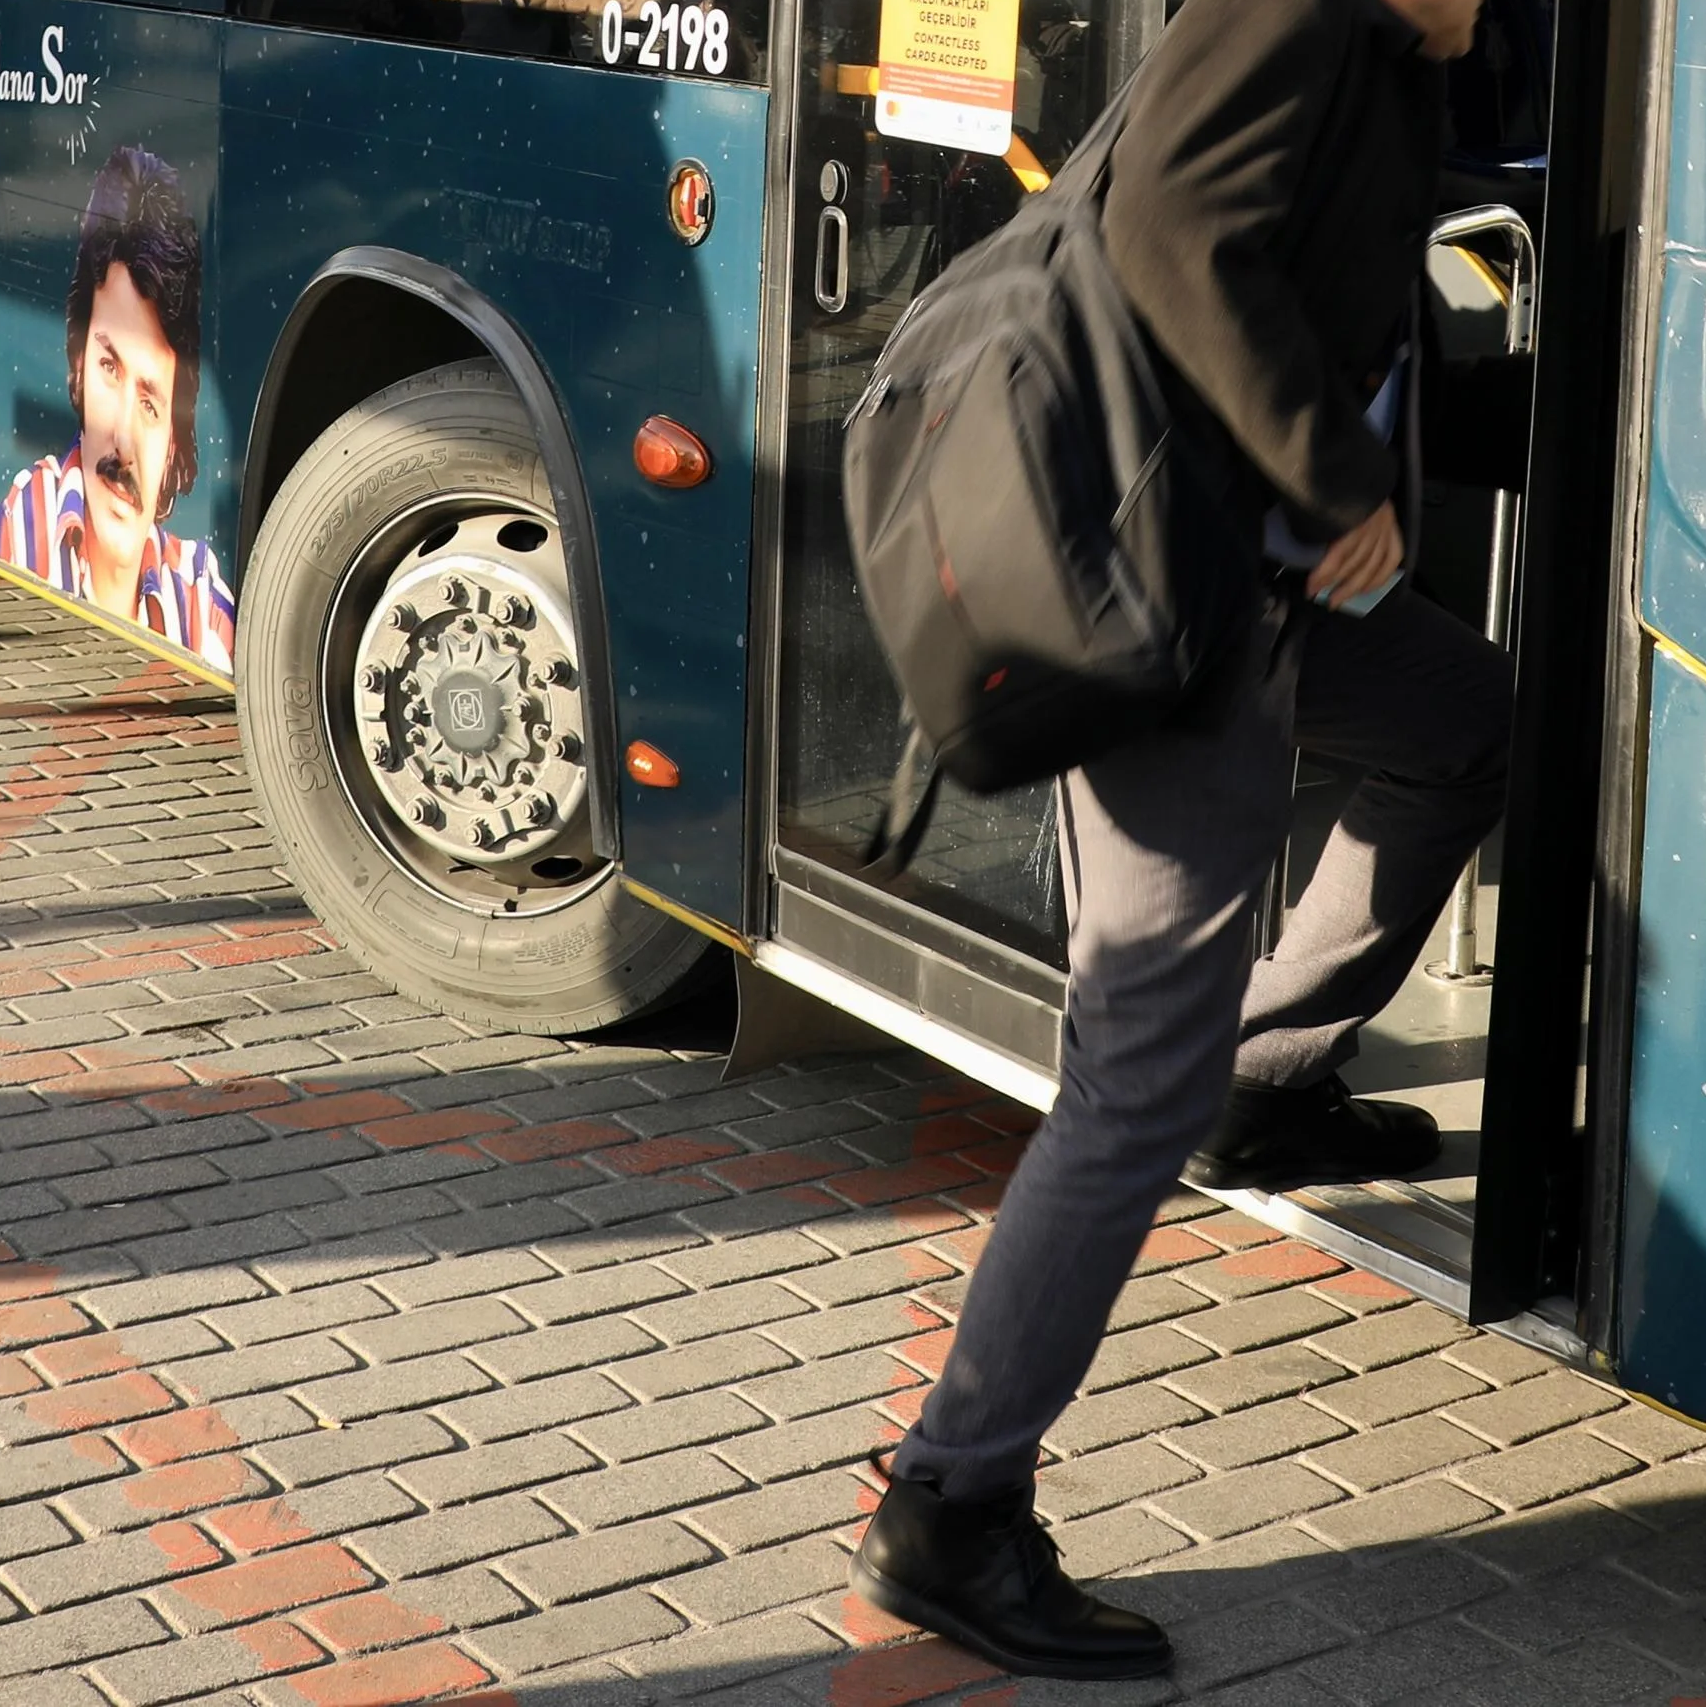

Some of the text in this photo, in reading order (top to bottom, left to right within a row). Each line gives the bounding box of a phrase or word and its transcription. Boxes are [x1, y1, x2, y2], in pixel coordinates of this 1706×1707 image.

[919, 10, 977, 30] GEÇERLİDİR
[914, 31, 981, 52] CONTACTLESS
[40, 24, 88, 106] Sor
[905, 48, 988, 71] CARDS ACCEPTED
[310, 446, 448, 559] 275/70R22.5
